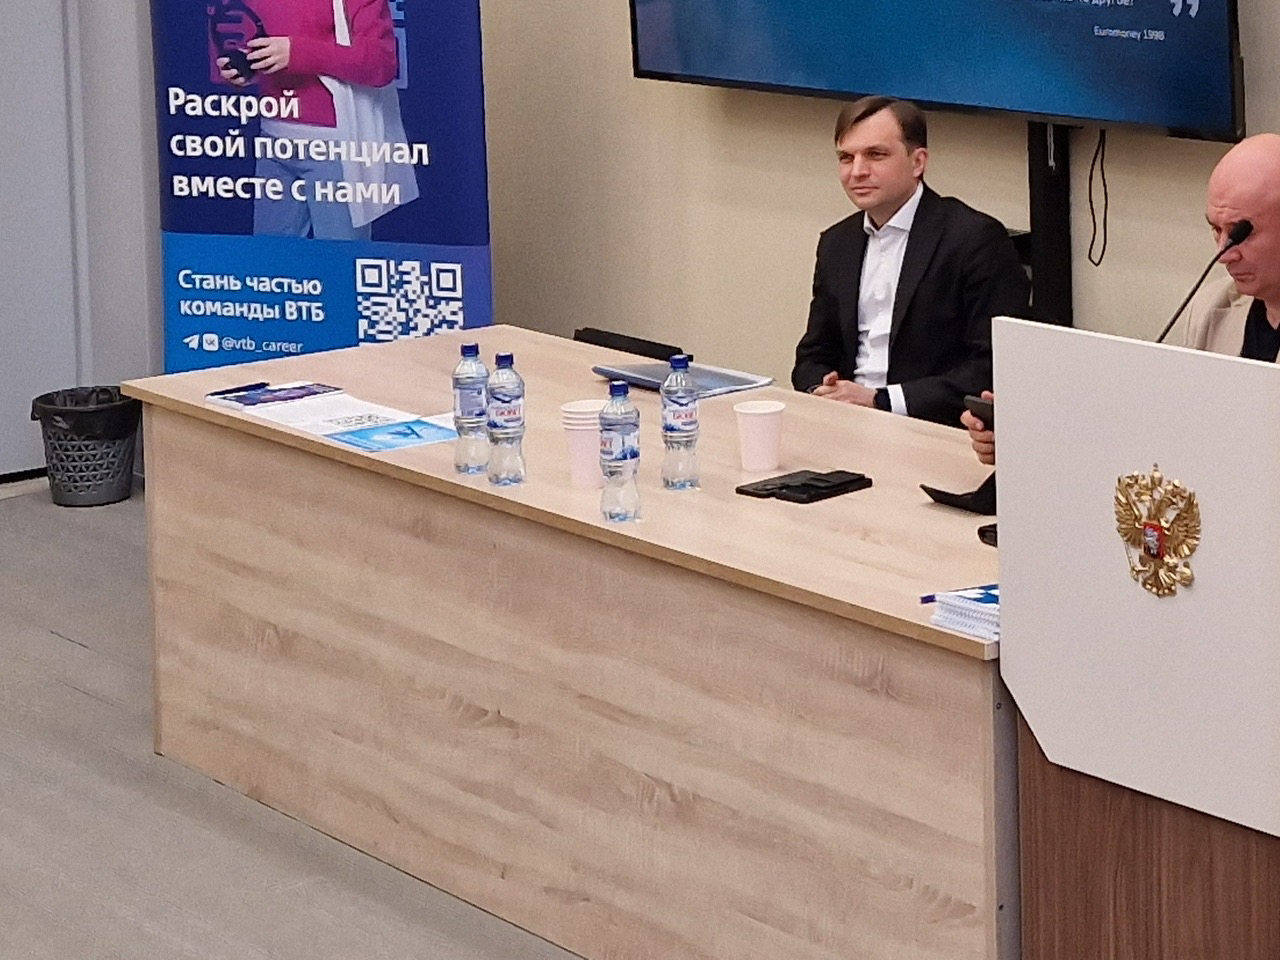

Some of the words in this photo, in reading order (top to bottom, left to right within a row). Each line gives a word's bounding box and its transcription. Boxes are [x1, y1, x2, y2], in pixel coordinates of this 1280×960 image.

[167, 87, 300, 124] Раскрой
[169, 128, 246, 158] свой
[254, 136, 430, 167] потенциал
[172, 175, 284, 199] вместе
[291, 180, 307, 201] с
[314, 181, 401, 205] нами
[178, 269, 242, 291] Стань
[245, 276, 323, 296] частью
[179, 300, 281, 322] команды
[284, 300, 326, 323] ВТБ
[222, 336, 305, 354] @vtb_career
